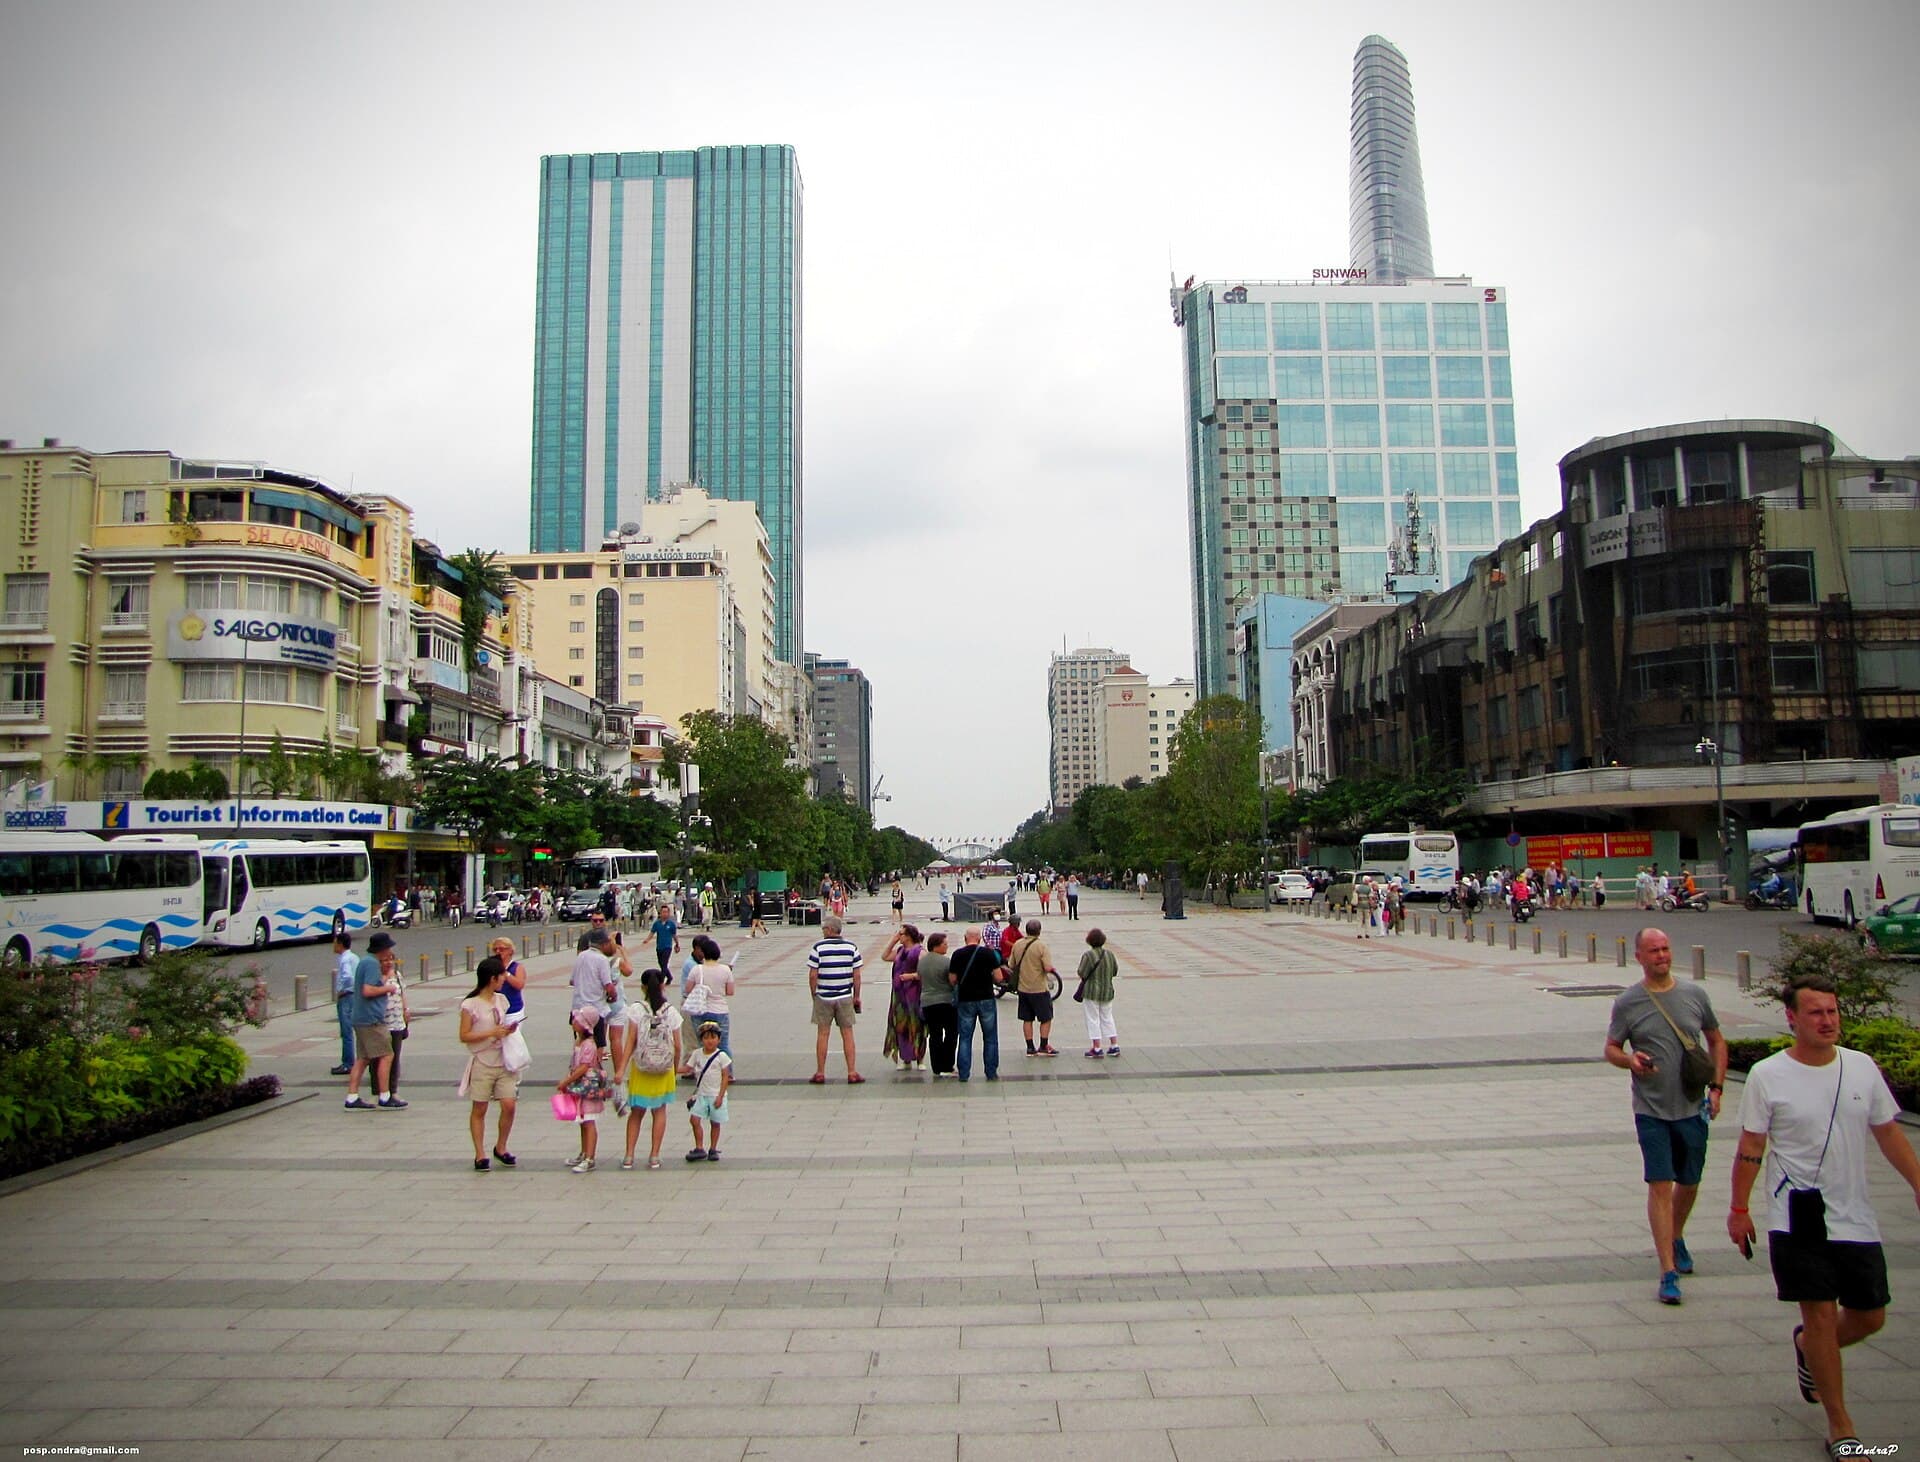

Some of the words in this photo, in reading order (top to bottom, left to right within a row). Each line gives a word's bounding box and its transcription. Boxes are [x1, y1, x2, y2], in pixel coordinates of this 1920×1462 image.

[1312, 268, 1367, 279] SUNWAH
[625, 552, 652, 561] OSCAR
[653, 551, 684, 560] SAIGON
[686, 551, 713, 560] HOTEL
[213, 618, 337, 649] SAIGONTOURIST
[145, 805, 222, 823] Tourist
[229, 805, 345, 824] Information
